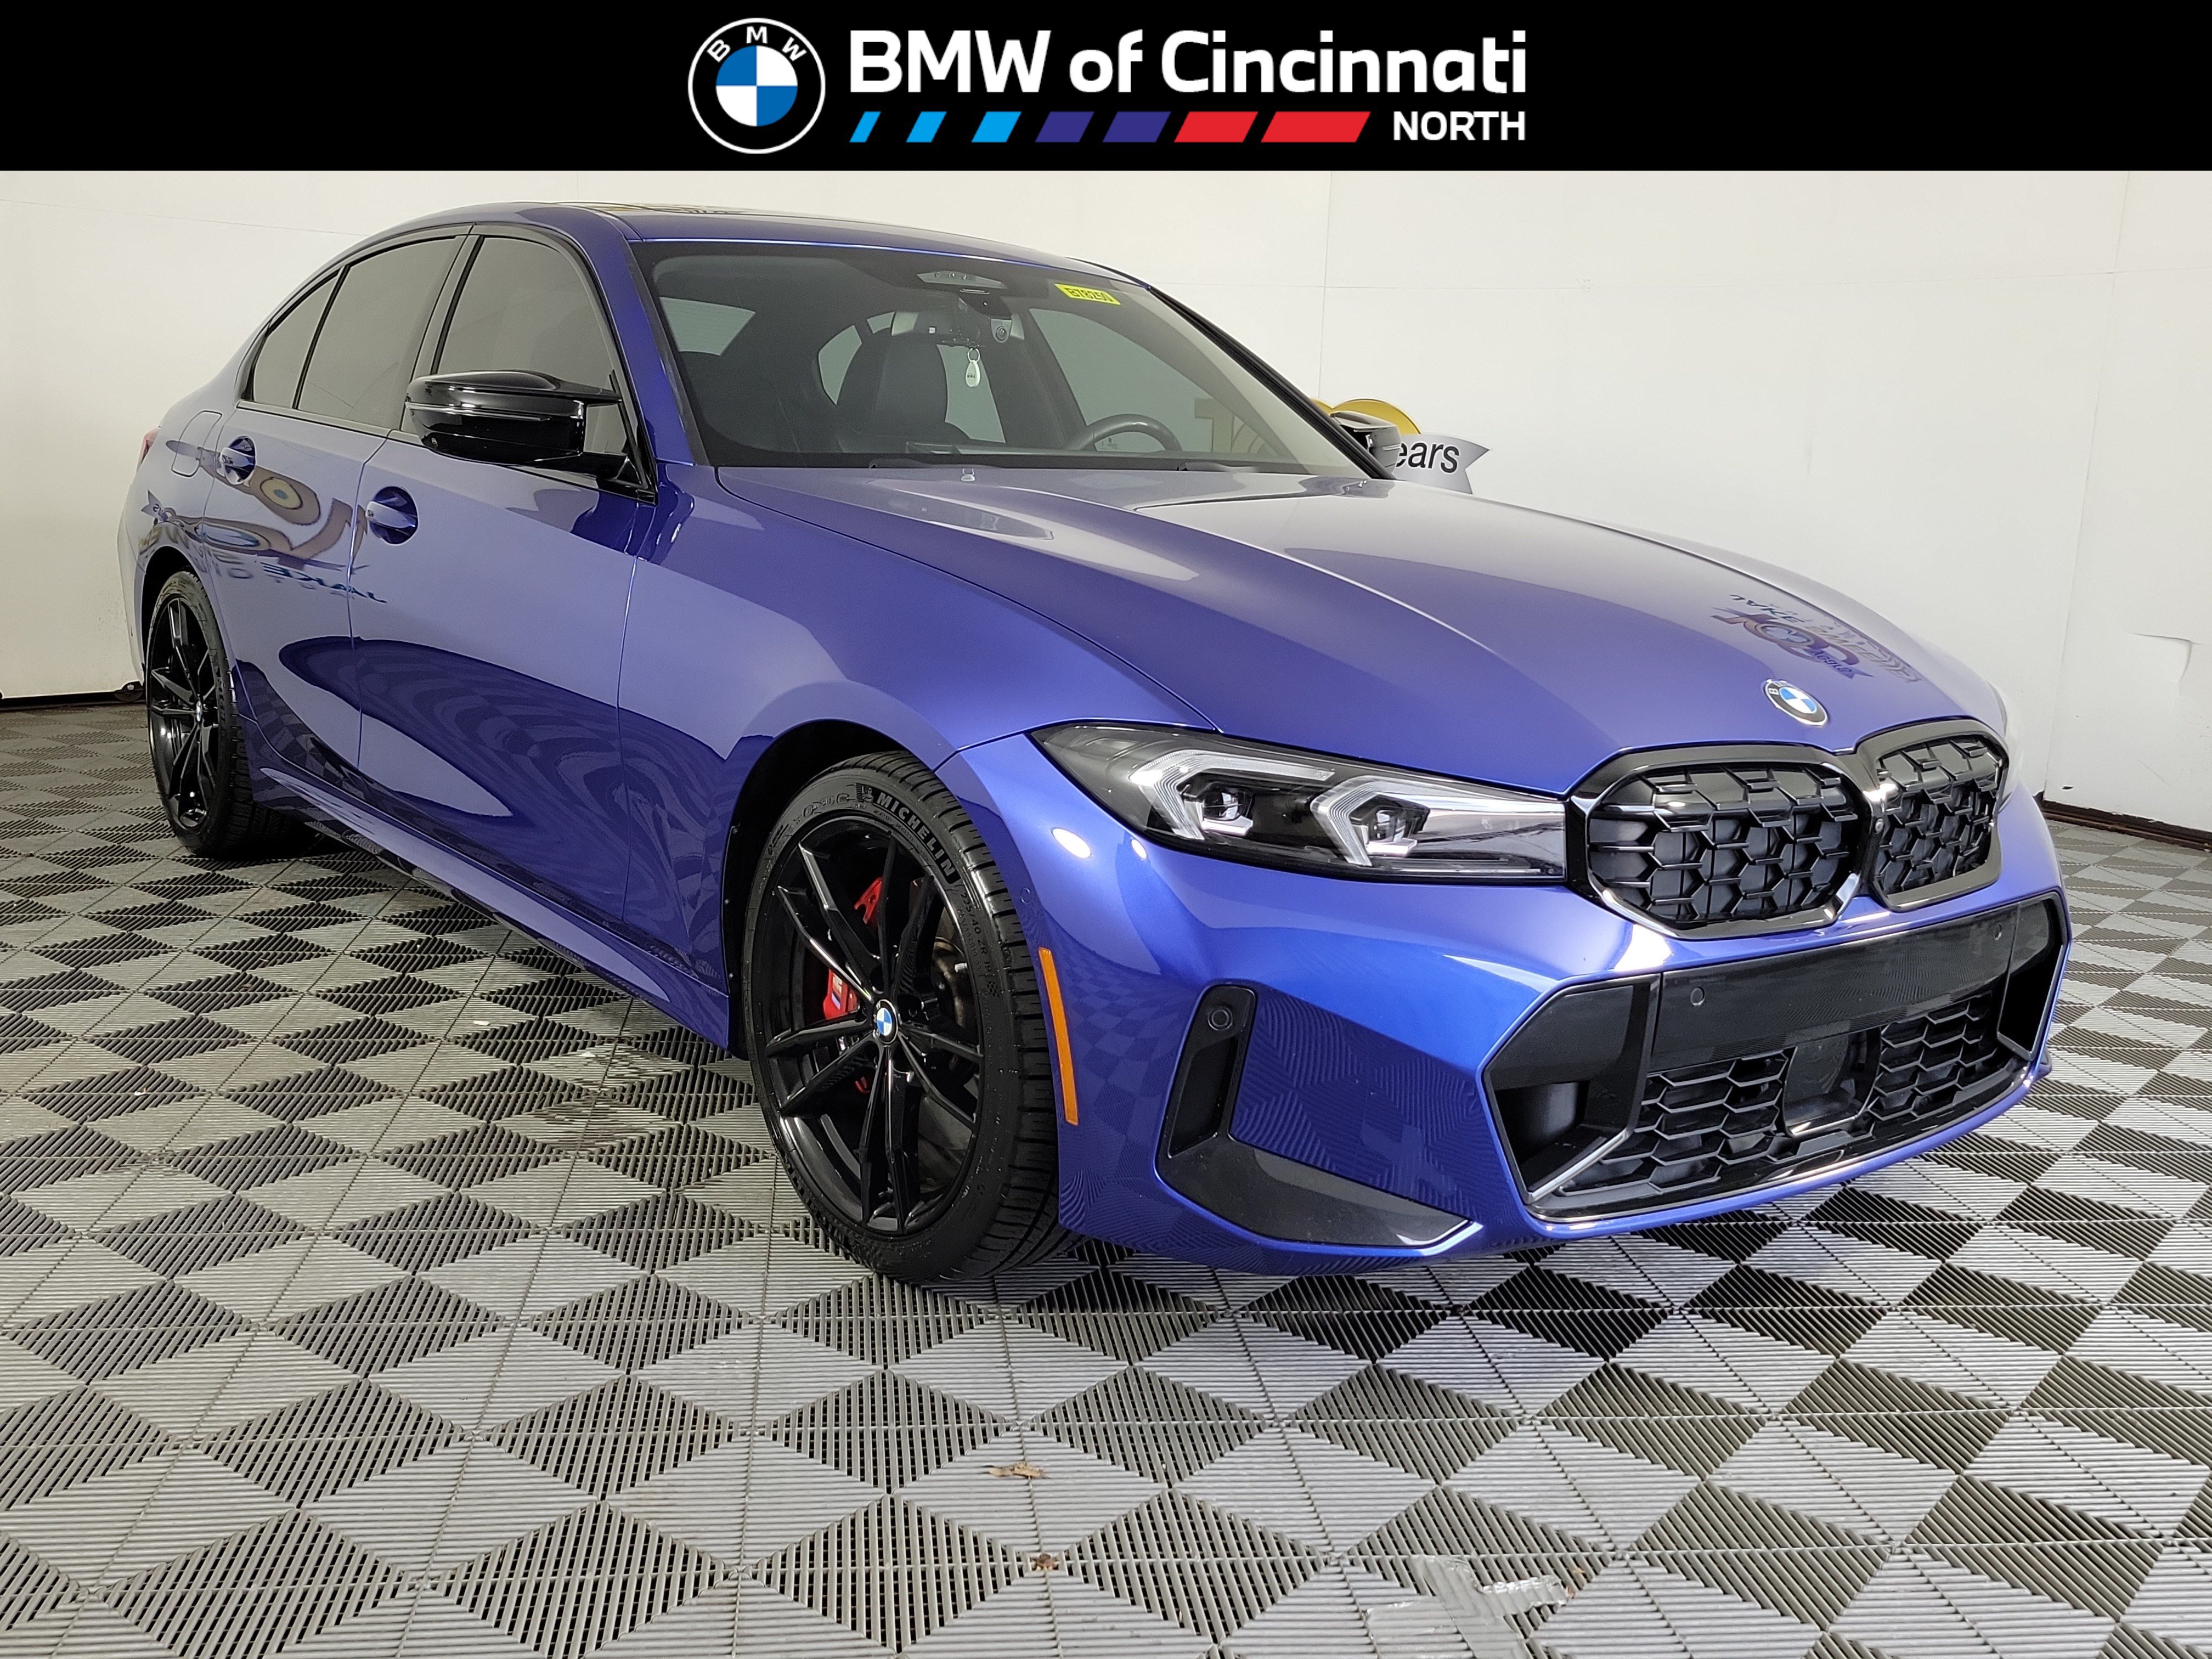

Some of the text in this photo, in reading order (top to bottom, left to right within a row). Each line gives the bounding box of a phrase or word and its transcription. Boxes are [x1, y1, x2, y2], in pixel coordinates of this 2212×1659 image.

[1395, 442, 1460, 473] ears
[876, 792, 956, 877] MICHELIN
[960, 892, 981, 934] 225/40
